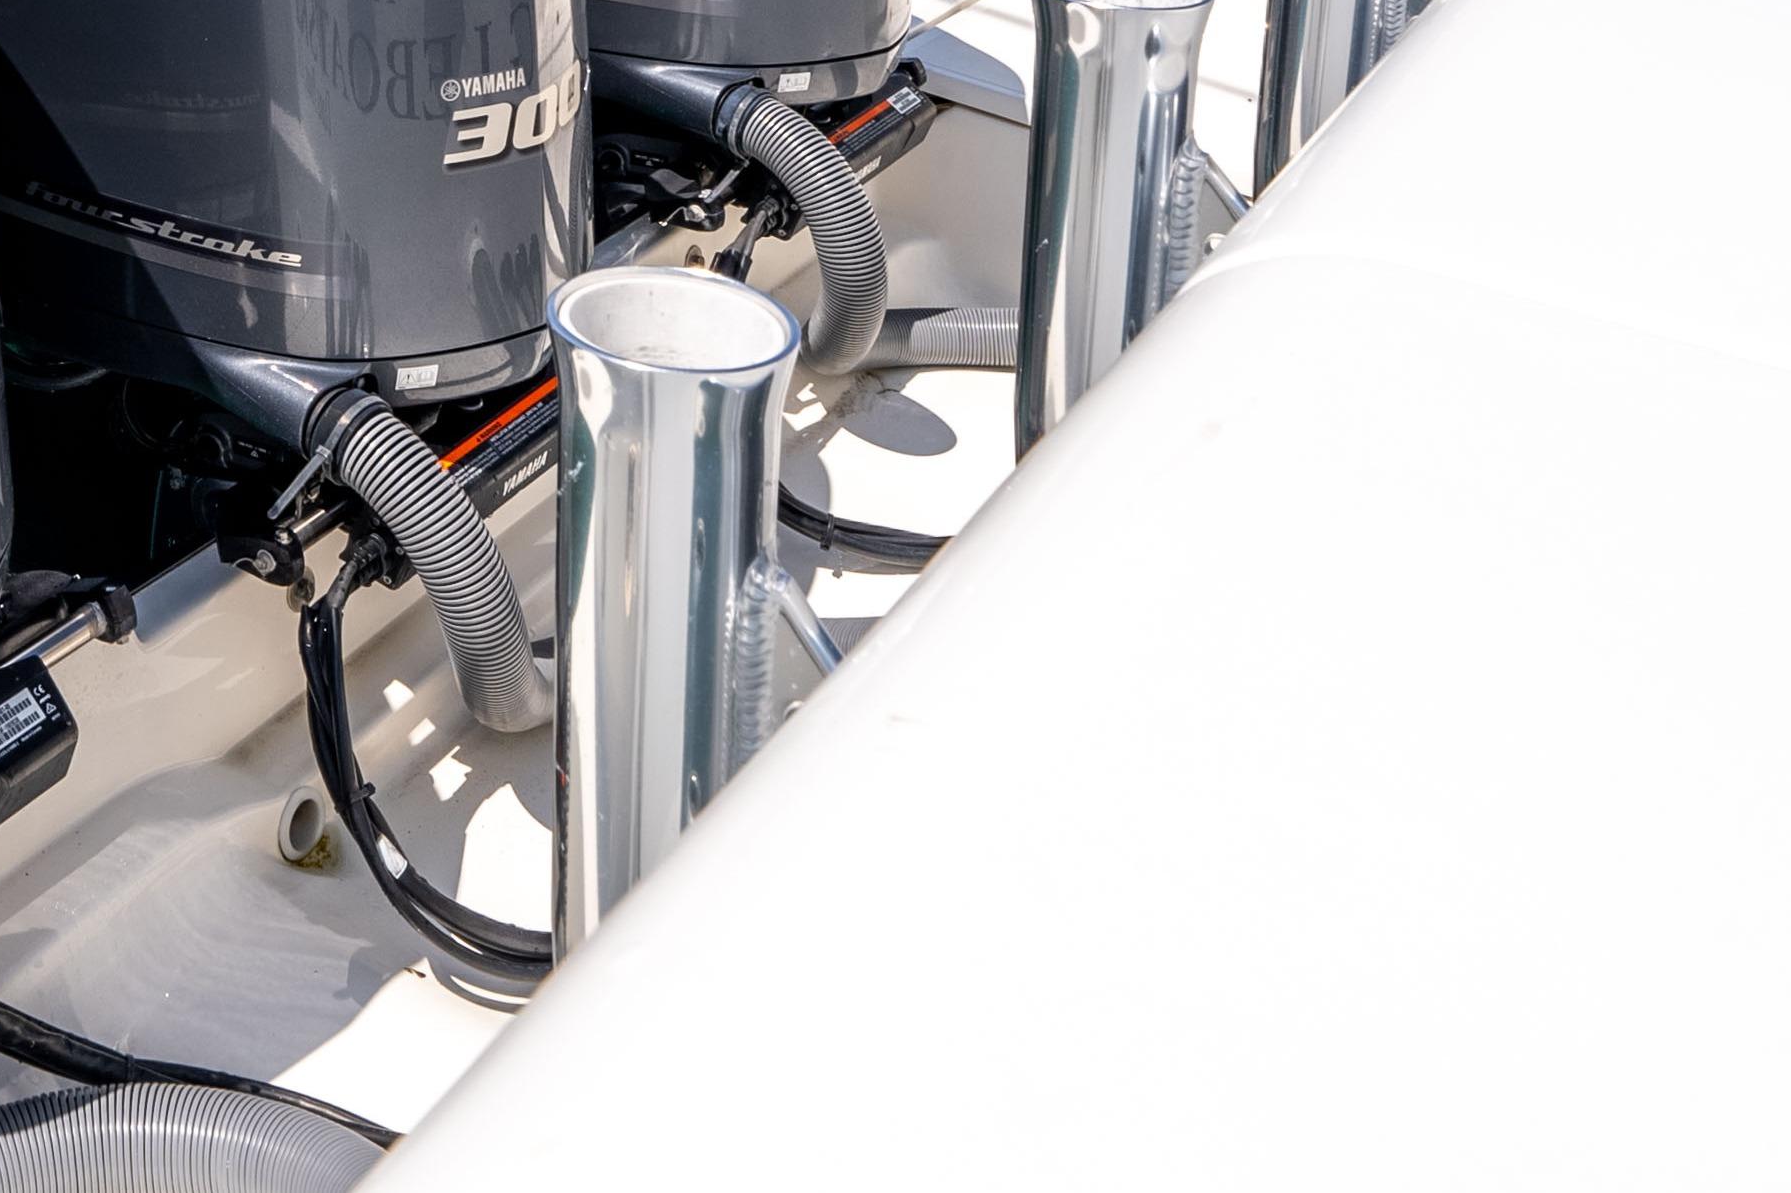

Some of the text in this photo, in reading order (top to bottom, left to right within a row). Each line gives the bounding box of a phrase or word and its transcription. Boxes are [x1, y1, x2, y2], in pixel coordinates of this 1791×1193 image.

[462, 67, 526, 98] YAMAHA
[443, 59, 581, 164] 300
[503, 450, 548, 497] YAMAHA
